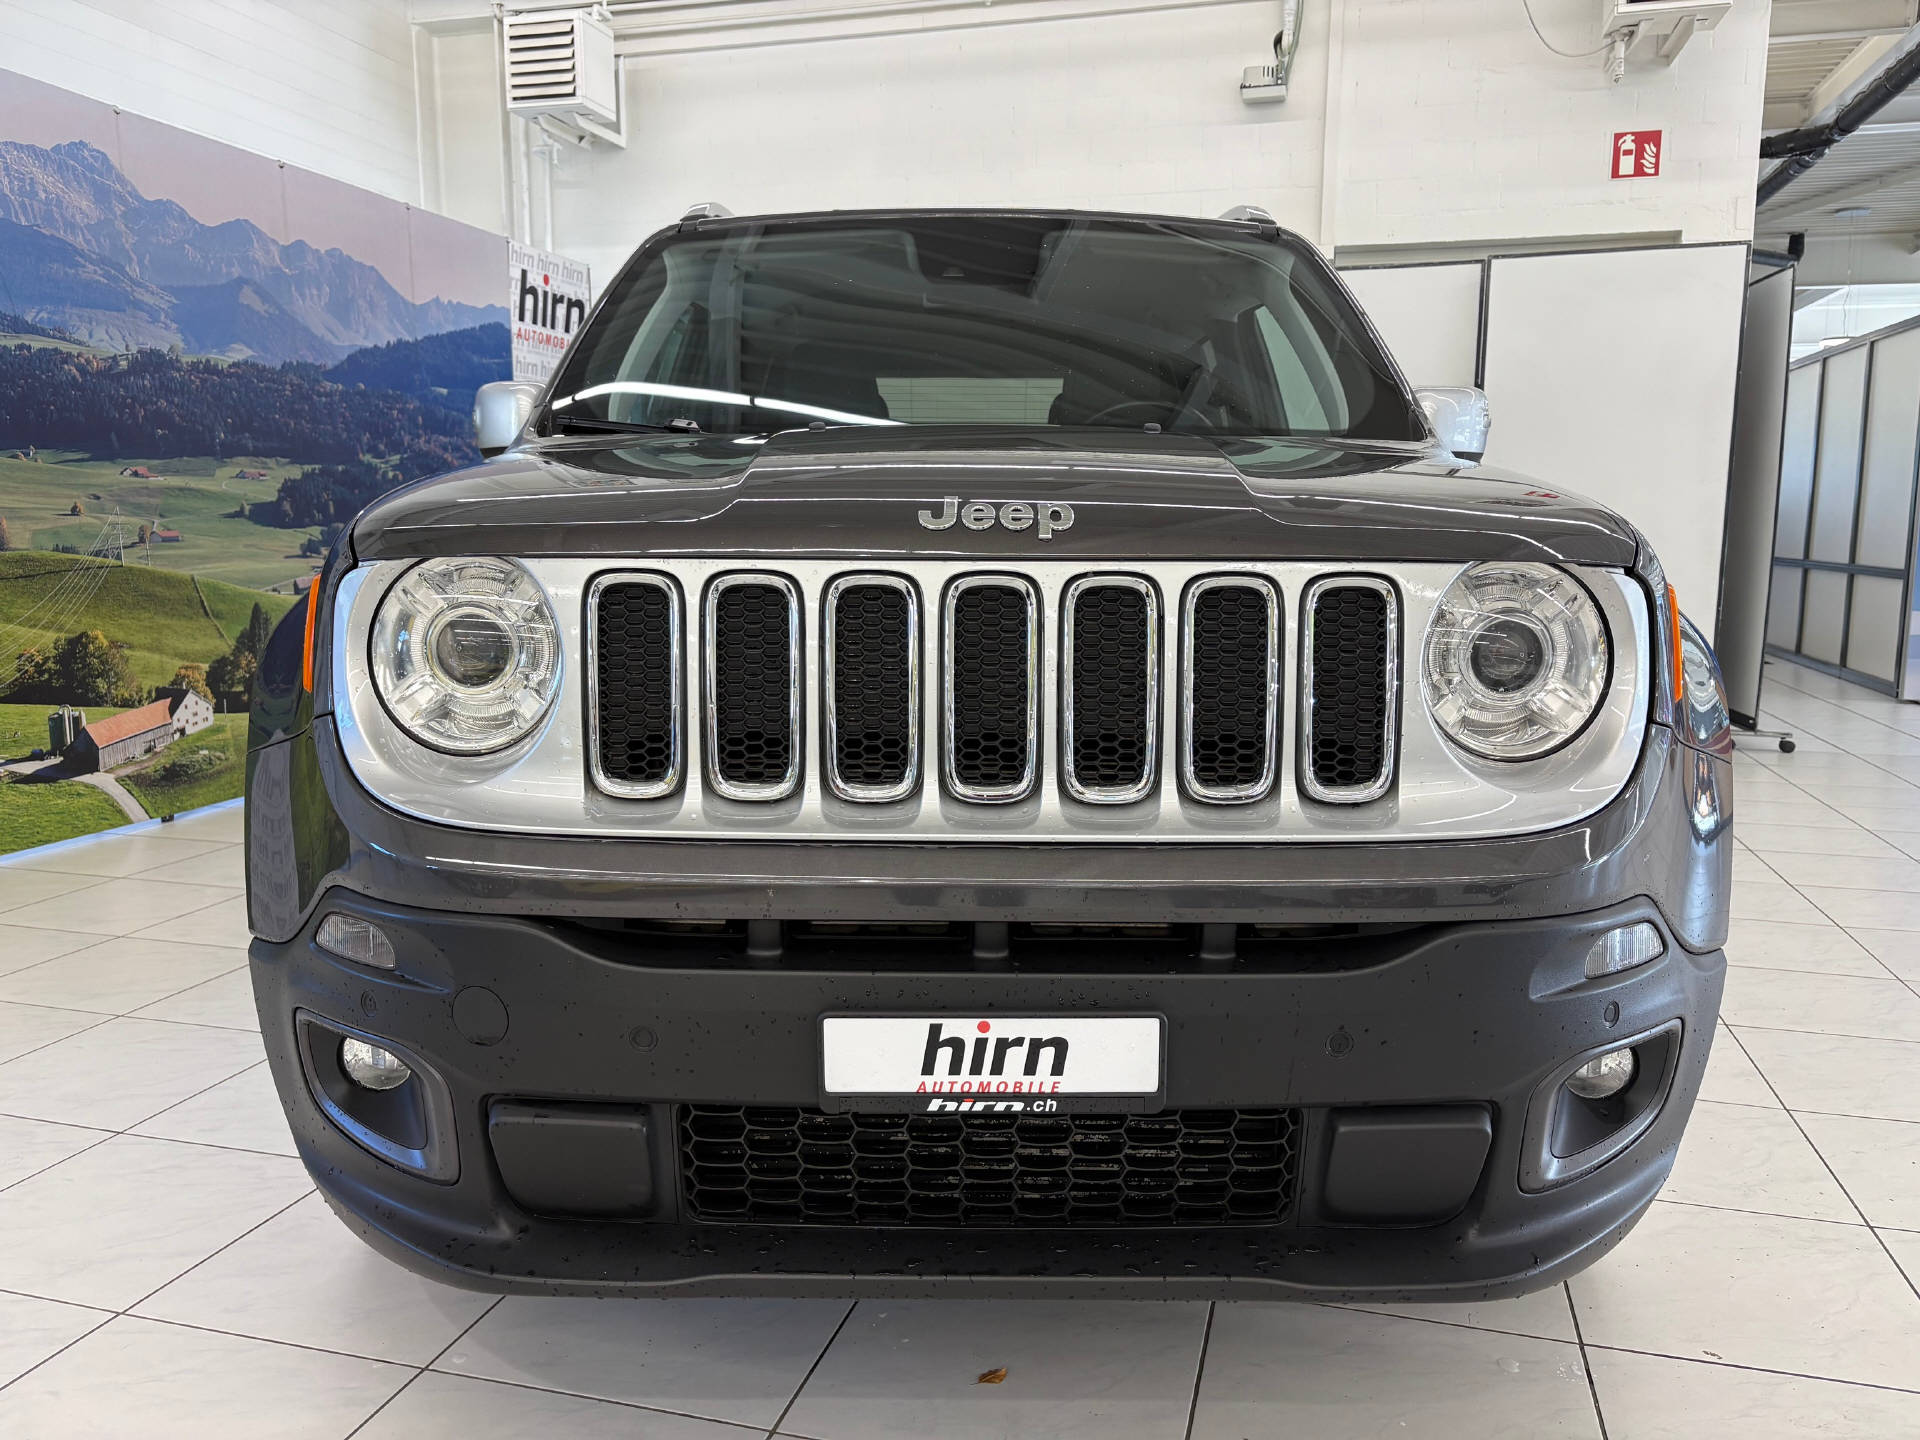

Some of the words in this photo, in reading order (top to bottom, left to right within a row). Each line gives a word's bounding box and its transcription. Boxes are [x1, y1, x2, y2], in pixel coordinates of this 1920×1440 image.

[511, 243, 534, 267] hirn
[537, 253, 559, 275] hirn
[562, 261, 583, 283] hirn
[519, 269, 585, 333] hirn
[516, 354, 537, 376] hirn
[918, 496, 1074, 539] Jeep
[920, 1020, 1069, 1076] hirn
[916, 1081, 1061, 1094] AUTOMOBILE
[926, 1098, 1057, 1112] hirn.ch
